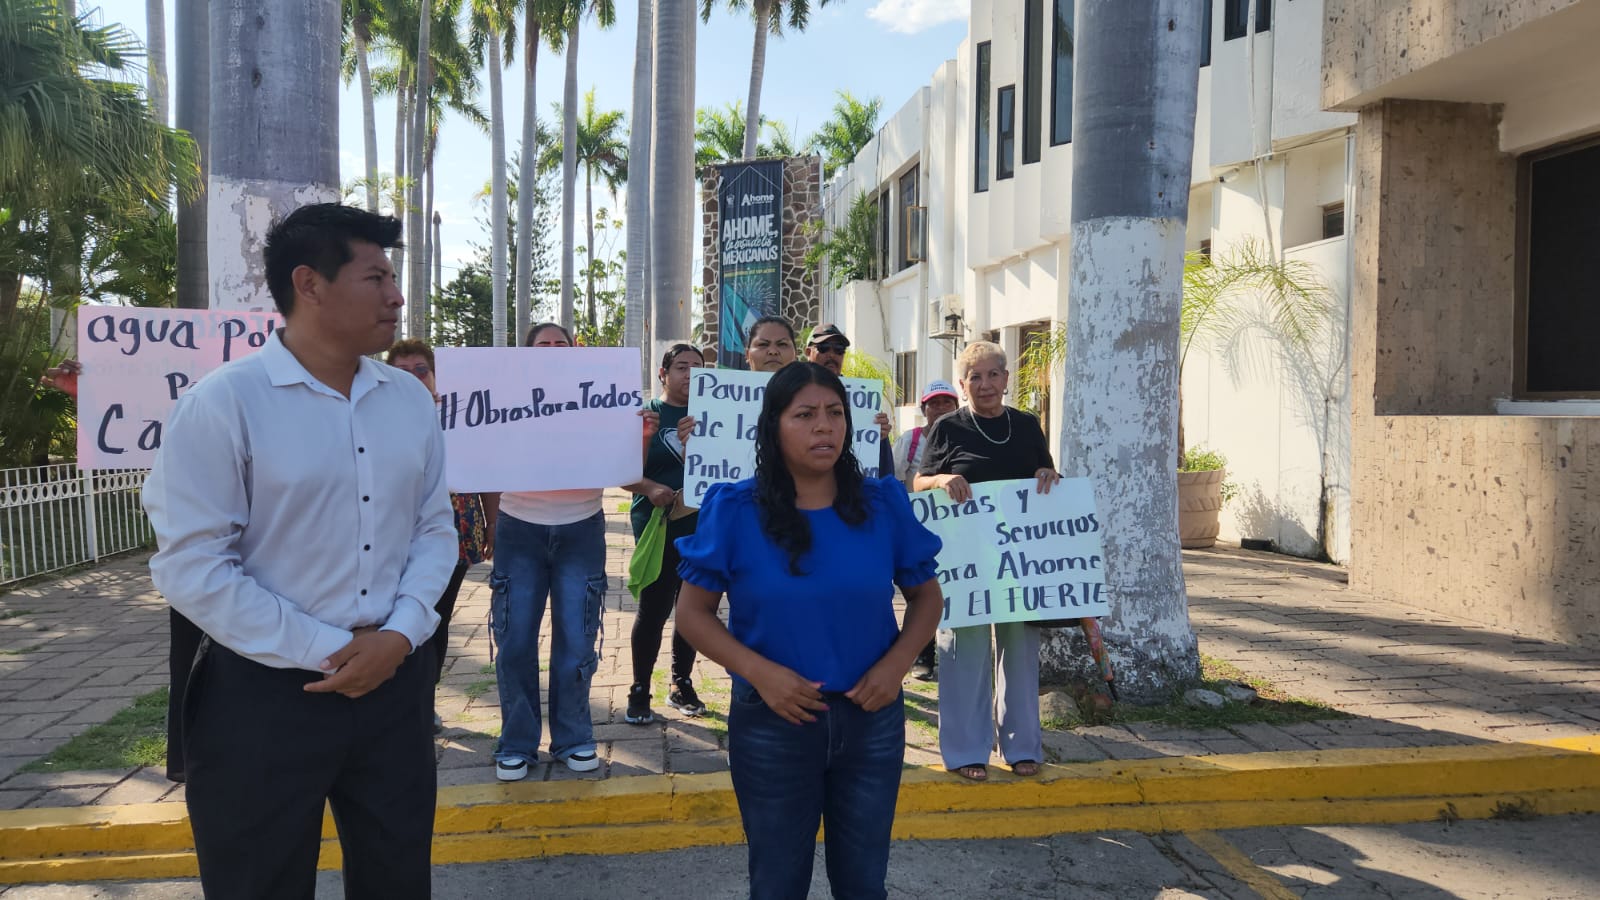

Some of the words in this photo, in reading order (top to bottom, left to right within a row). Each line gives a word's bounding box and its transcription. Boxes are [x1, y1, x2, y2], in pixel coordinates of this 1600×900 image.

[741, 193, 775, 207] Ahome
[722, 214, 778, 242] AHOME,
[88, 315, 200, 356] agua
[437, 381, 643, 431] #ObrasParaTodos
[690, 411, 724, 438] de
[911, 492, 996, 524] Obras
[996, 513, 1099, 546] Servicios
[937, 563, 978, 585] ara
[997, 550, 1102, 580] Ahome
[1002, 582, 1111, 613] FUERTE
